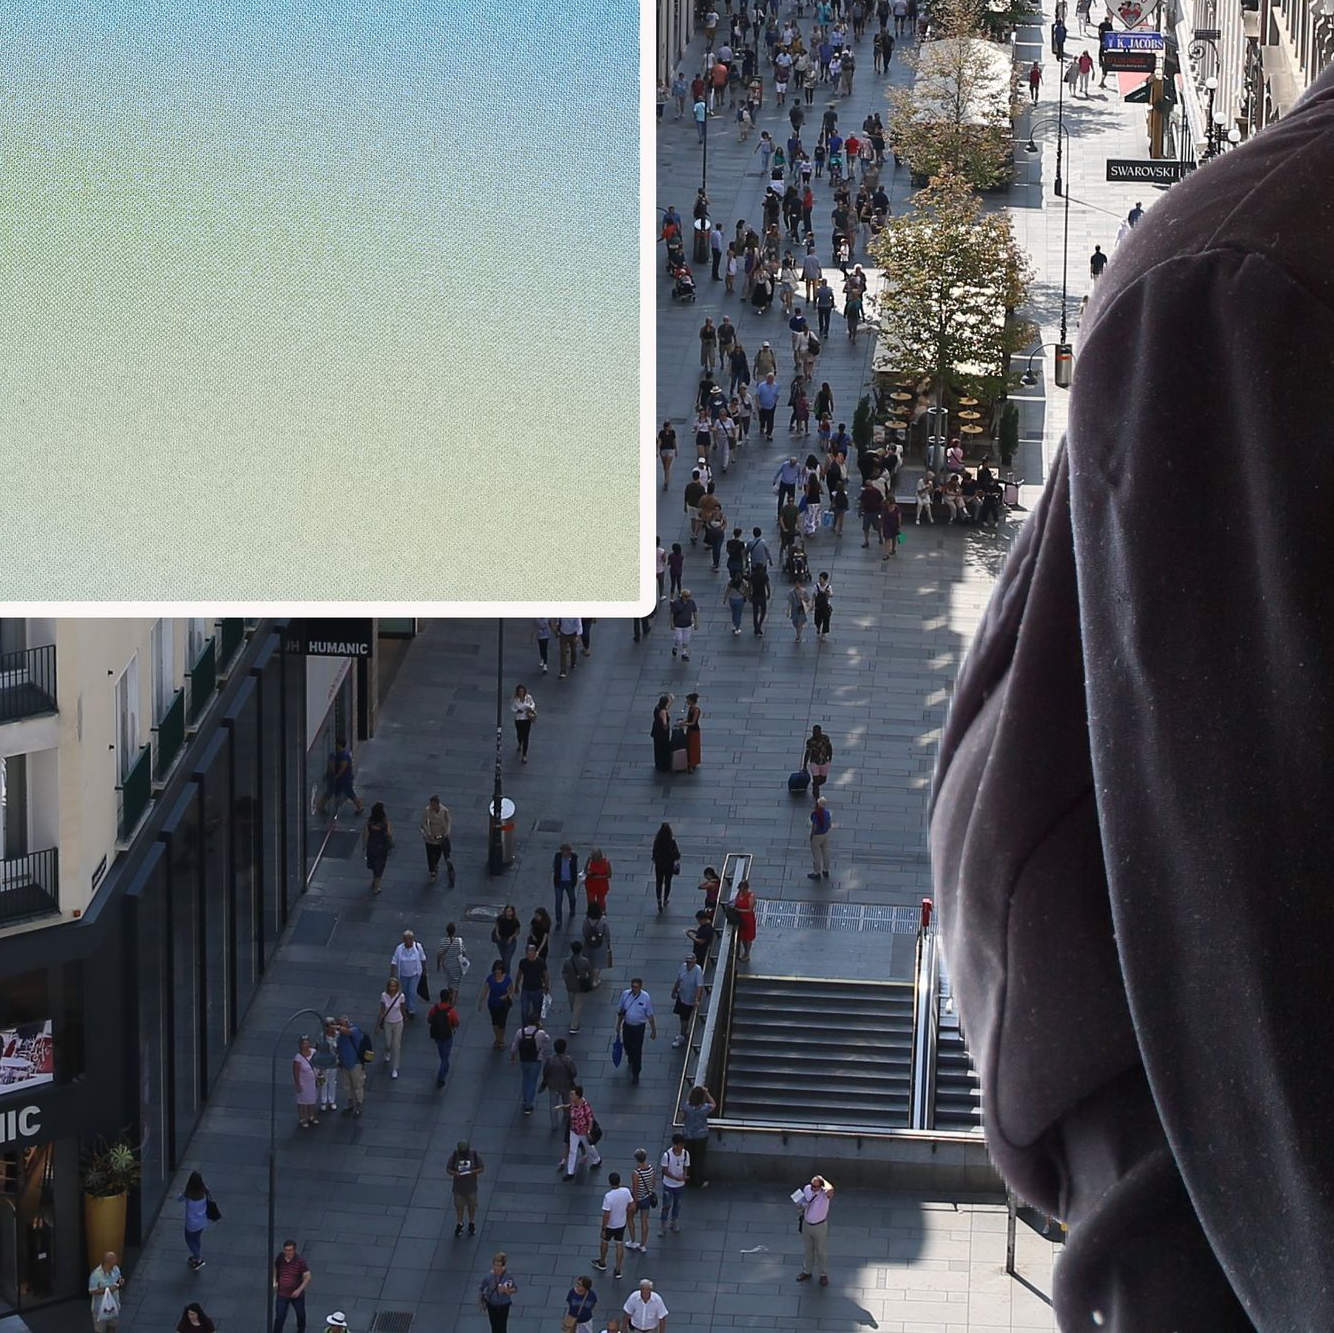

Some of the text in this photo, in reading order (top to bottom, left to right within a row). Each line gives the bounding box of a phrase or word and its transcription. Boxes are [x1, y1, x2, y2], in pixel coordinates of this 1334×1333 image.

[1117, 38, 1164, 49] K. JACOBS
[1110, 165, 1175, 177] SWAROVSKI
[308, 640, 369, 655] HUMANIC
